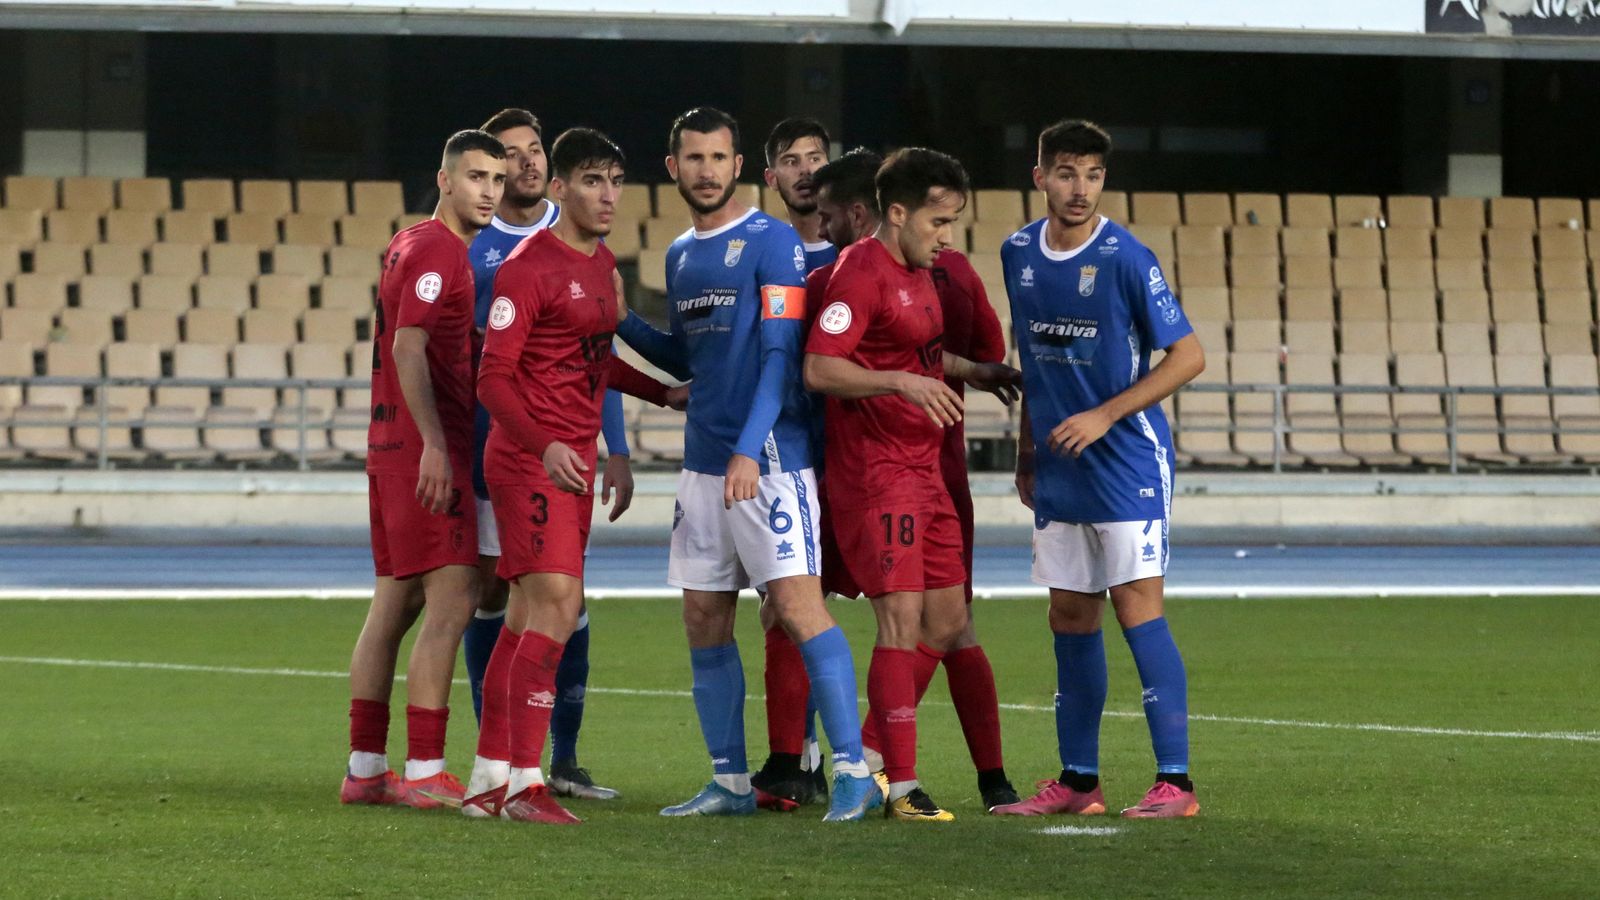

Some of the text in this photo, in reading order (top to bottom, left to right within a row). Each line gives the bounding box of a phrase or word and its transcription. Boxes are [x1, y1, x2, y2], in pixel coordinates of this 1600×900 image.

[676, 294, 736, 313] Torralva
[1029, 320, 1098, 338] Torralva
[530, 493, 548, 526] 3
[769, 497, 793, 534] 6
[881, 513, 915, 547] 18
